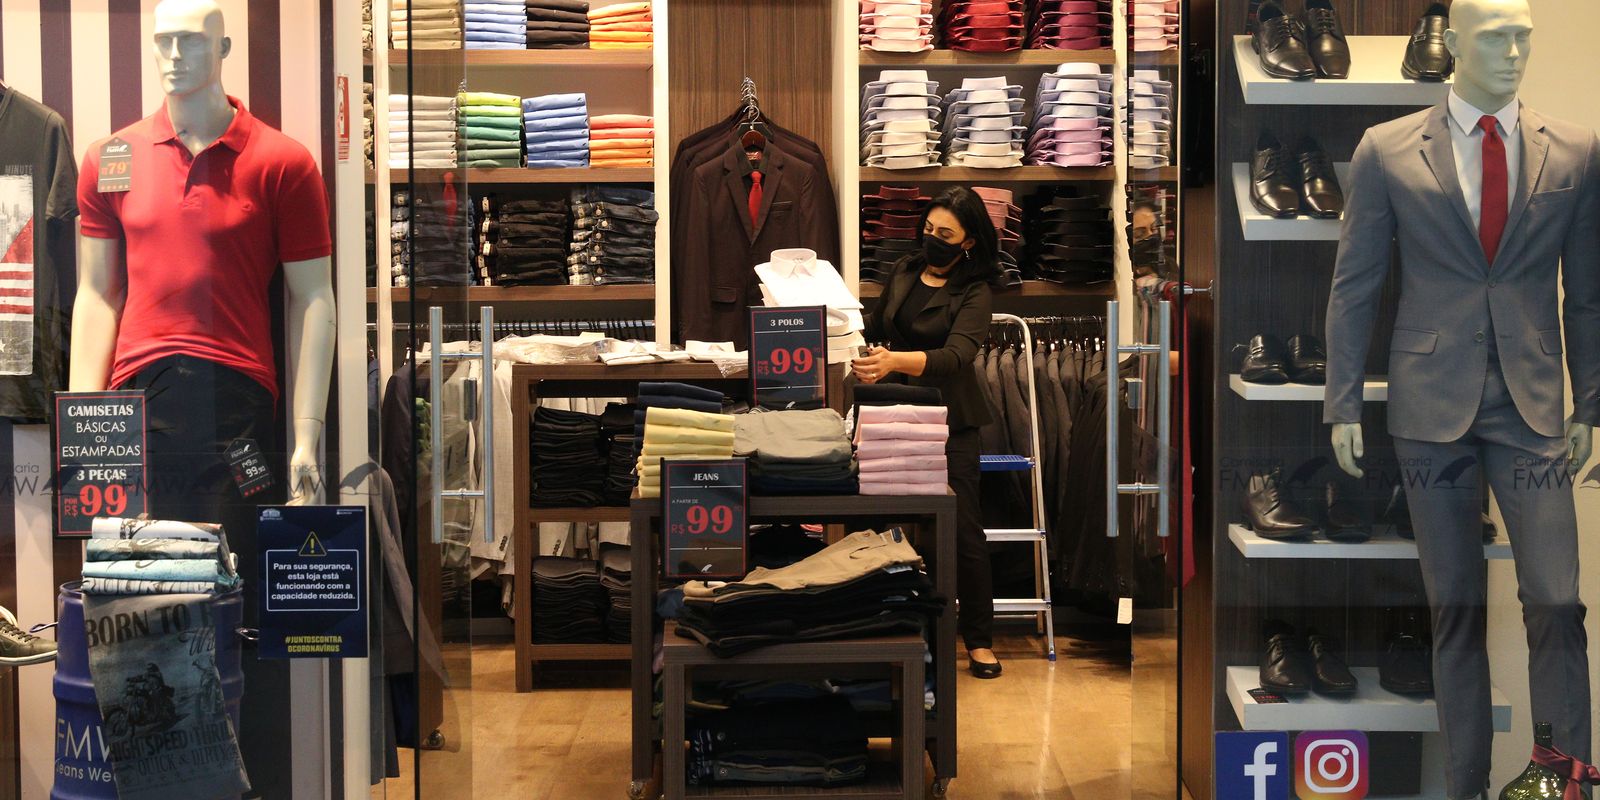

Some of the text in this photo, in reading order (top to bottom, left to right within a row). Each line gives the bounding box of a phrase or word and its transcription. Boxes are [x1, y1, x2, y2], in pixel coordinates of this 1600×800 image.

[107, 161, 127, 176] 79
[770, 318, 804, 327] 3 POLOS
[770, 347, 813, 375] 99
[67, 404, 134, 417] CAMISETAS
[76, 420, 126, 433] BÁSICAS
[95, 435, 108, 443] OU
[62, 444, 141, 458] ESTAMPADAS
[76, 469, 85, 481] 3
[88, 468, 127, 483] PEÇAS
[693, 473, 719, 481] JEANS
[1514, 468, 1578, 490] FMW
[80, 484, 127, 516] 99
[64, 505, 79, 517] R$
[671, 504, 734, 535] R$ 99
[309, 563, 353, 572] segurança,
[306, 572, 321, 582] loja
[322, 572, 340, 580] está
[276, 582, 326, 590] funcionando
[271, 592, 356, 601] capacidade reduzida.
[86, 610, 150, 649] BORN
[156, 603, 191, 635] TO
[285, 636, 343, 644] #JUNTOSCONTRA
[145, 729, 188, 756] SPEED
[138, 754, 176, 777] QUICK
[87, 766, 113, 783] We
